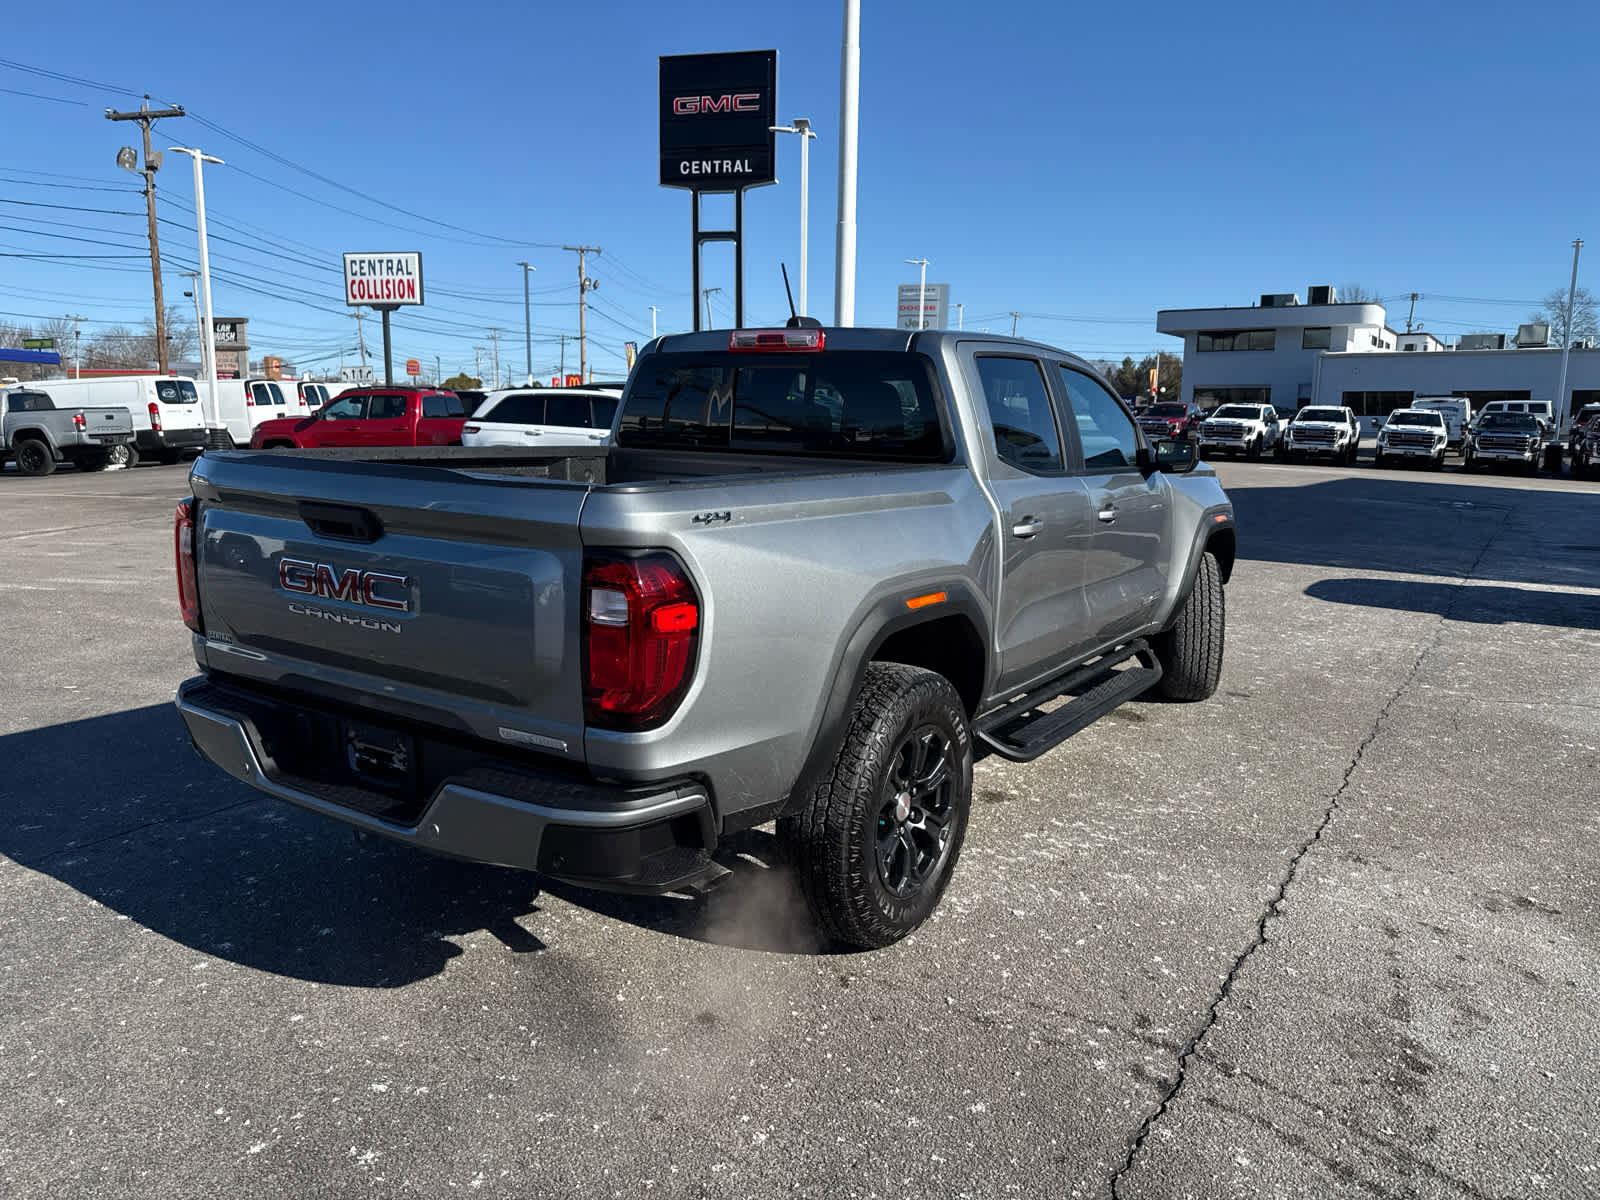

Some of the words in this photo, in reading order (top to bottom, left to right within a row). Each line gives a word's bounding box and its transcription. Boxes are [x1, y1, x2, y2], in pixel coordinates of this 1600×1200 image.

[673, 93, 760, 115] GMC
[680, 159, 753, 175] CENTRAL
[350, 258, 413, 276] CENTRAL
[350, 278, 415, 299] COLLISION
[279, 557, 409, 612] GMC
[287, 602, 402, 634] CANYON
